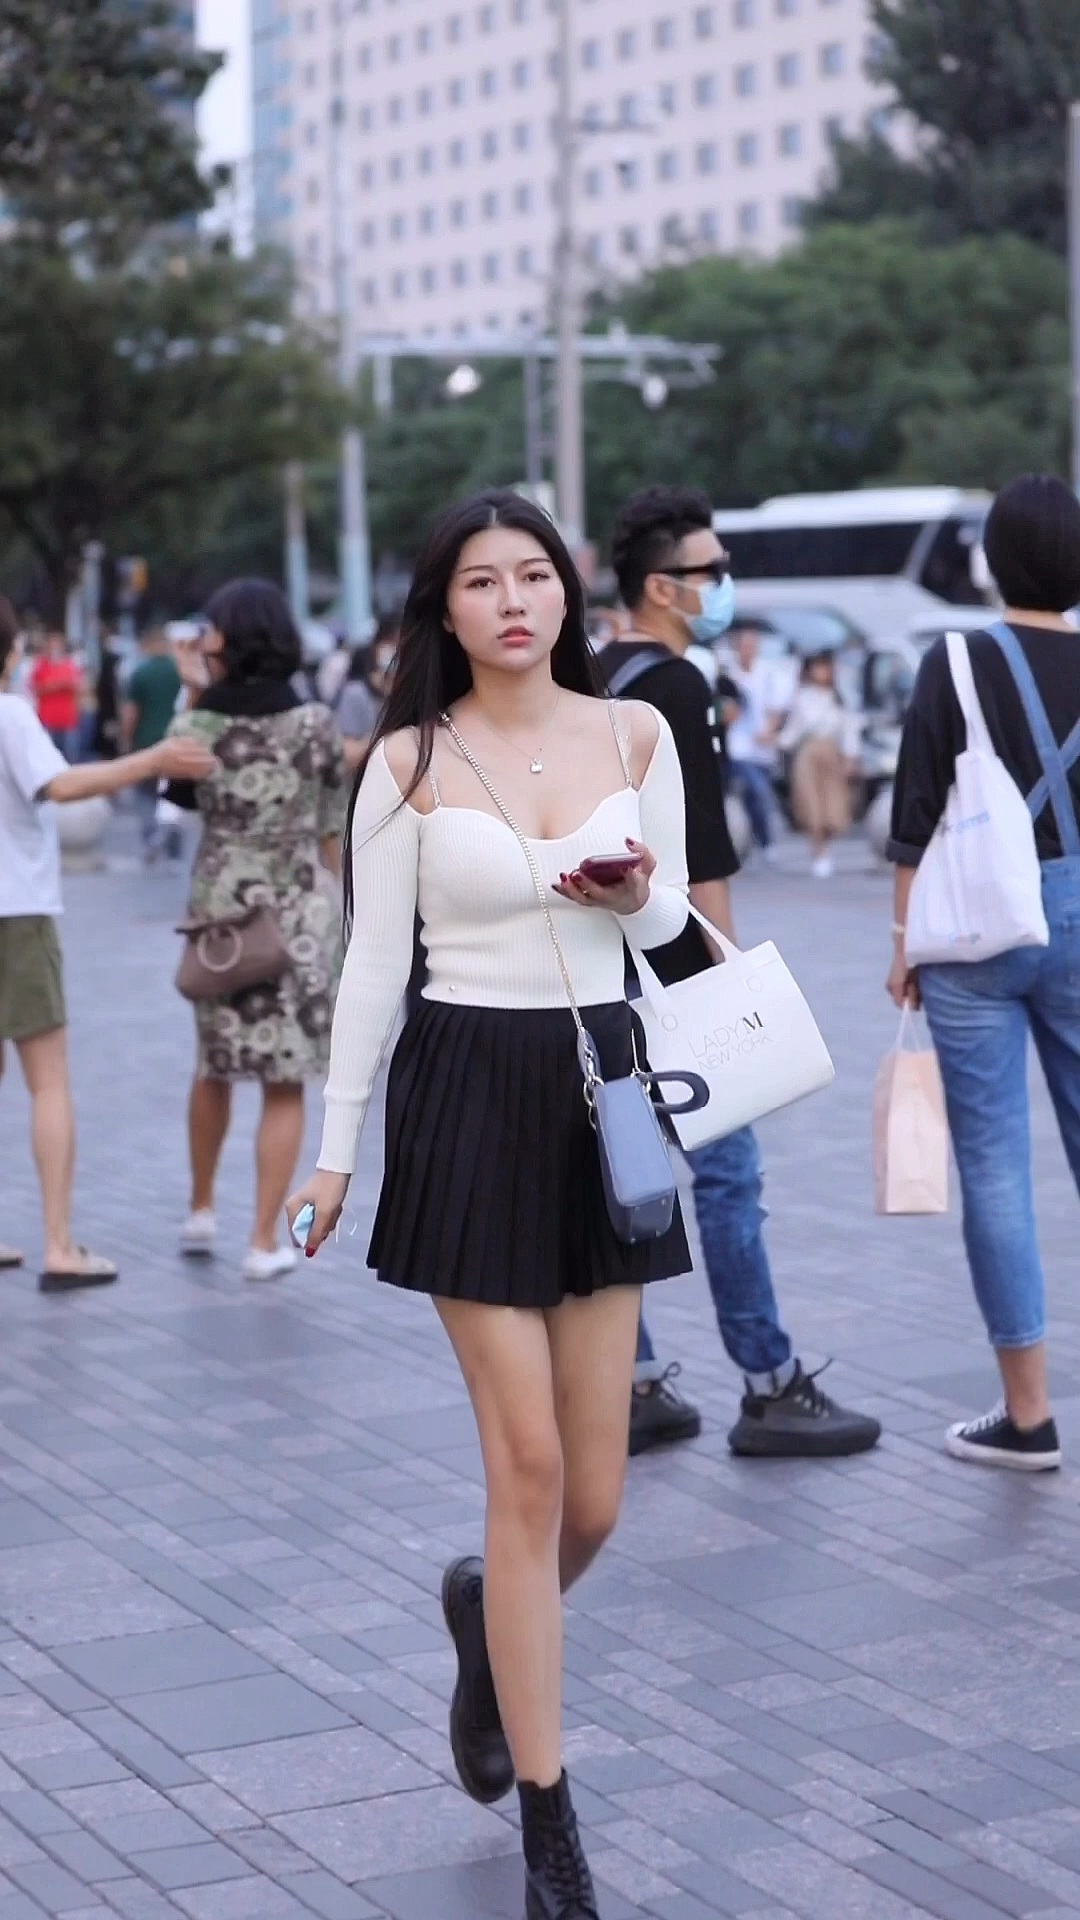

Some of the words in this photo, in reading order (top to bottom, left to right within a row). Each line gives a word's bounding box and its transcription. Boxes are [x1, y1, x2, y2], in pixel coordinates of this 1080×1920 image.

[688, 1019, 740, 1058] LADY
[741, 1011, 763, 1034] M
[698, 1048, 730, 1072] NEW
